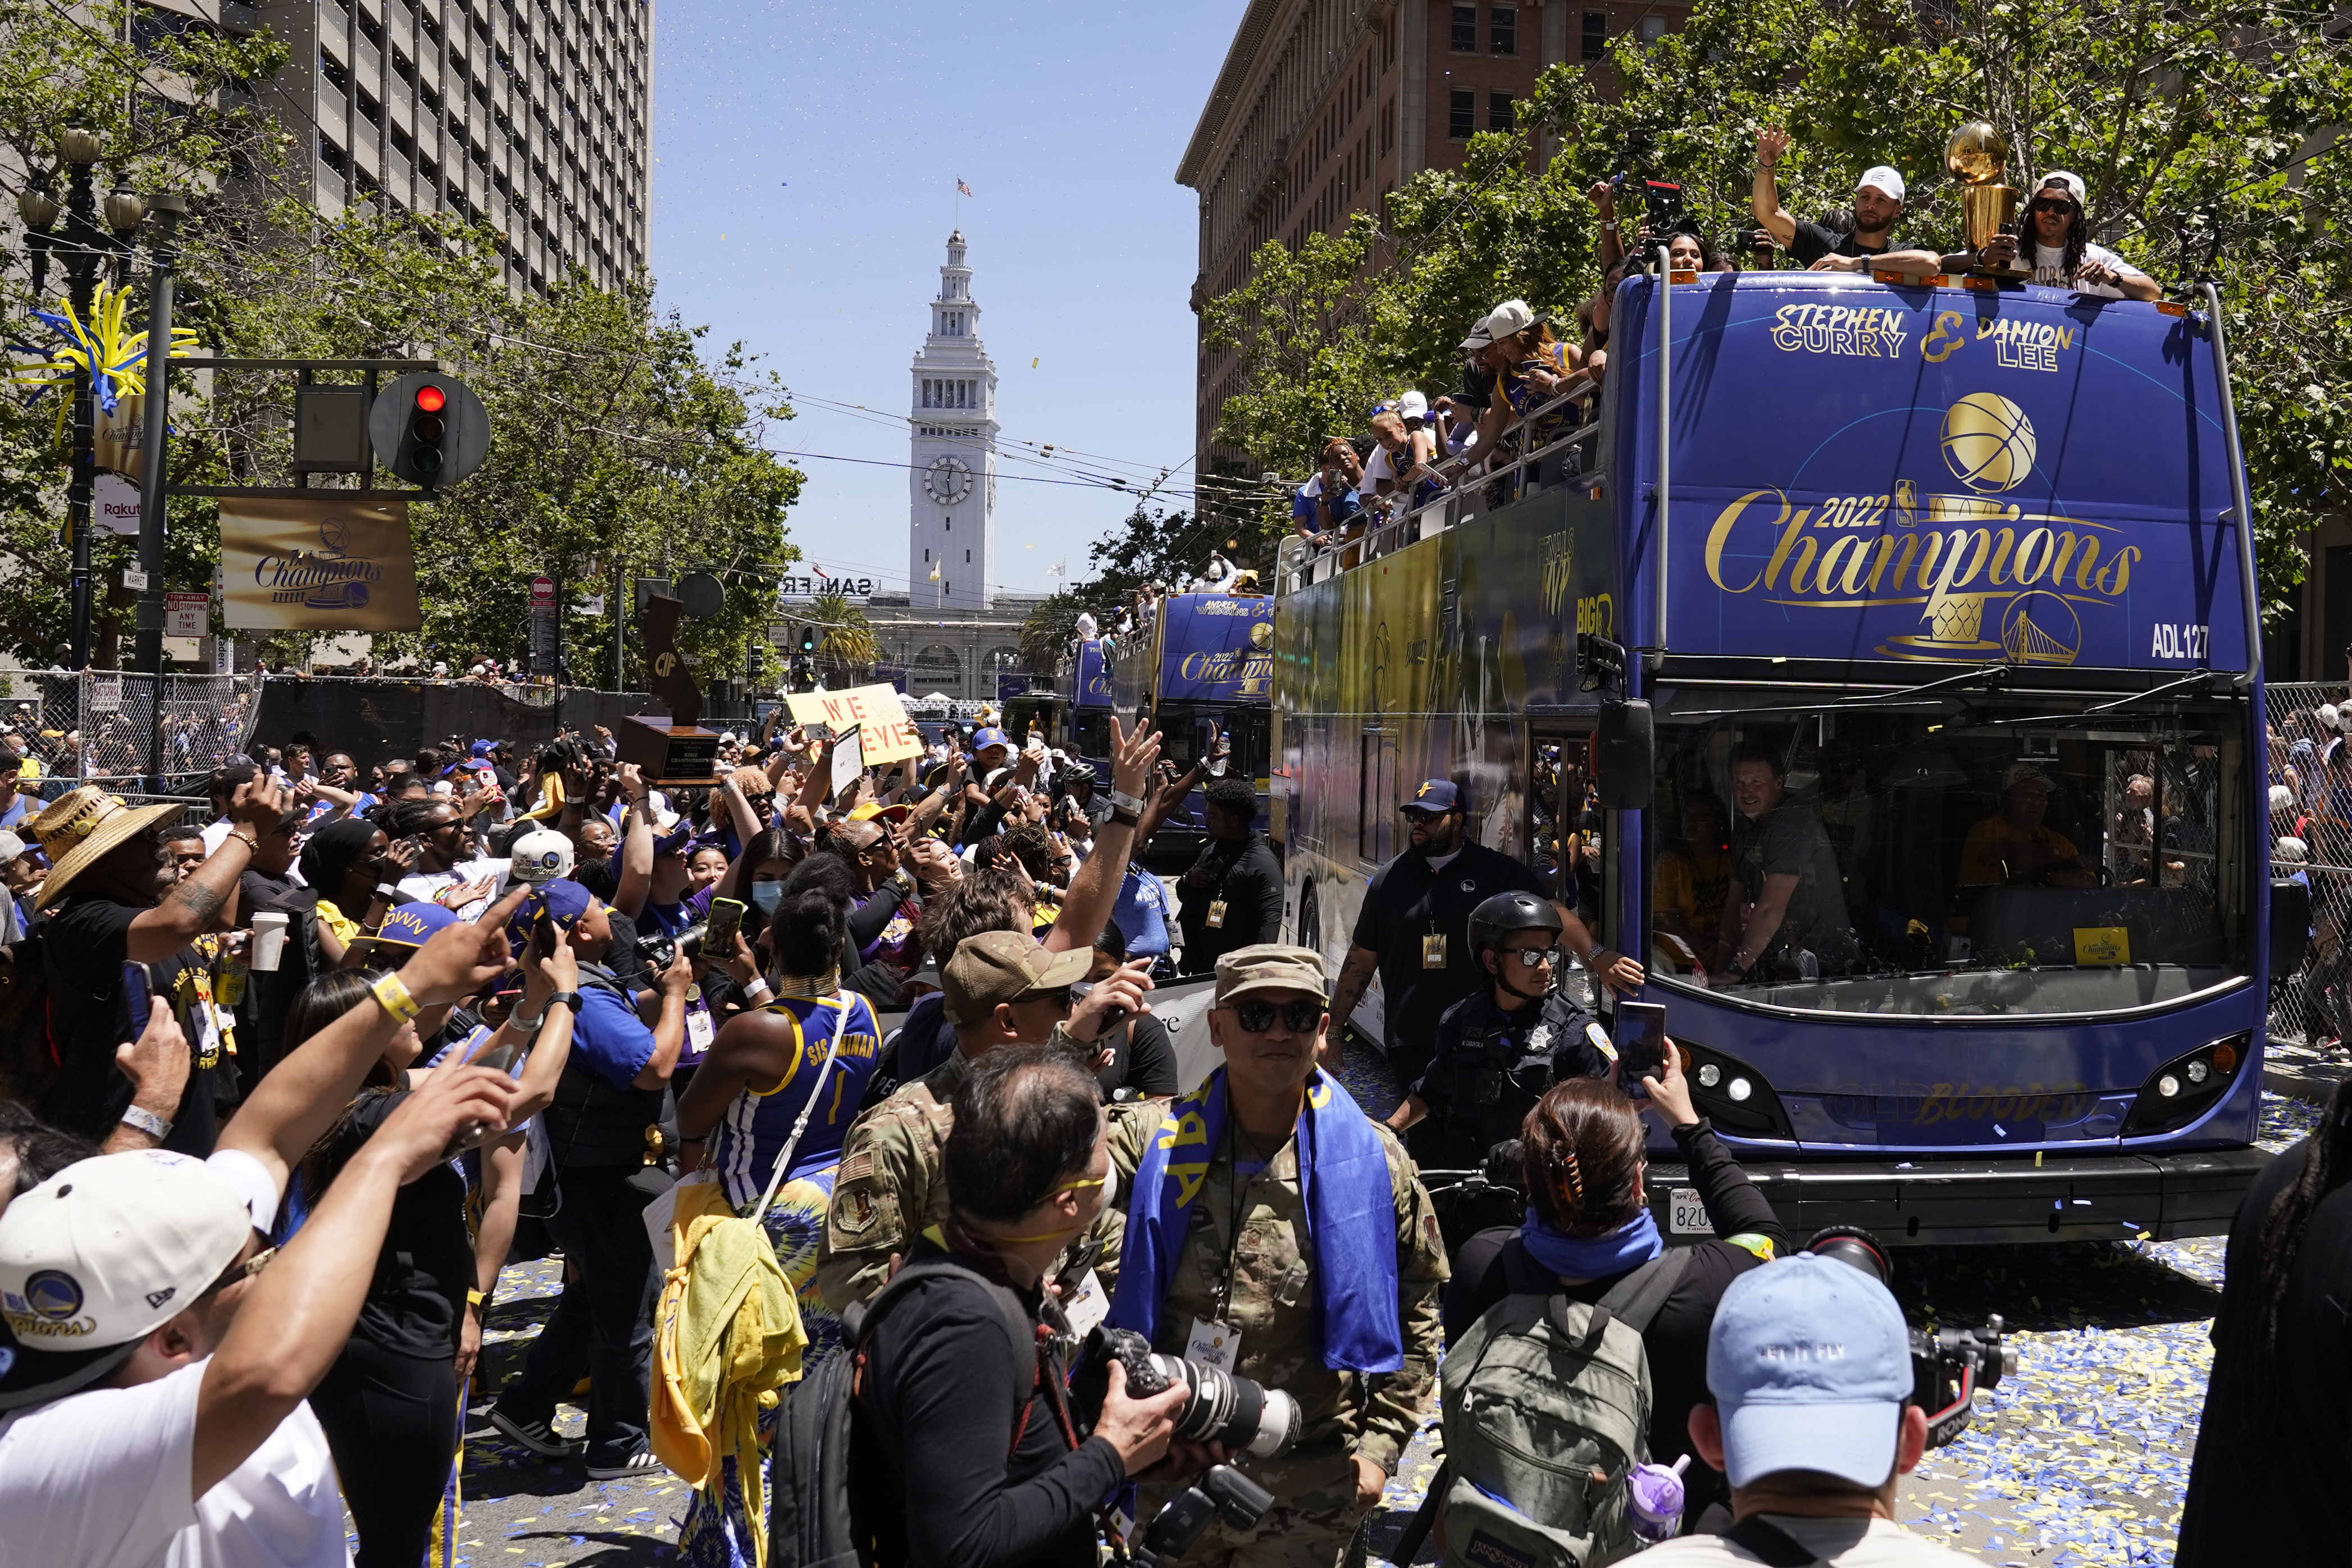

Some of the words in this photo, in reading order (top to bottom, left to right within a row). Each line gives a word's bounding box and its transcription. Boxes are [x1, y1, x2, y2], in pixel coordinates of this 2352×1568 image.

[1770, 303, 1903, 335] STEPHEN
[1920, 311, 1964, 363] &
[1976, 317, 2075, 350] DAMION
[1773, 326, 1907, 358] CURRY
[1997, 340, 2058, 372] LEE
[104, 503, 140, 515] Rakut
[1813, 495, 1891, 528] 2022
[1899, 516, 1910, 525] NBA
[1538, 527, 1574, 568] FINALS
[1704, 483, 2141, 625] Champions
[127, 573, 145, 587] MARKET
[255, 554, 384, 592] Champions
[168, 601, 179, 611] NO
[180, 603, 206, 612] STOPPING
[1196, 605, 1248, 617] WIGGINS
[1205, 600, 1240, 610] ANDREW
[1251, 601, 1265, 617] &
[2152, 623, 2209, 660] ADL127
[655, 652, 677, 677] CIF
[1212, 652, 1234, 663] 2022
[822, 696, 867, 722] WE
[2083, 944, 2121, 954] Champions
[807, 1038, 828, 1066] SIS
[828, 1069, 846, 1124] 1
[1913, 1082, 2090, 1126] BLOODED
[1689, 1192, 1701, 1202] Ca
[1676, 1206, 1713, 1227] 820
[1192, 1339, 1230, 1360] Champions
[1756, 1346, 1785, 1361] LET
[1794, 1346, 1808, 1361] IT
[1816, 1343, 1845, 1361] FLY
[1471, 1539, 1529, 1568] JANSPORT
